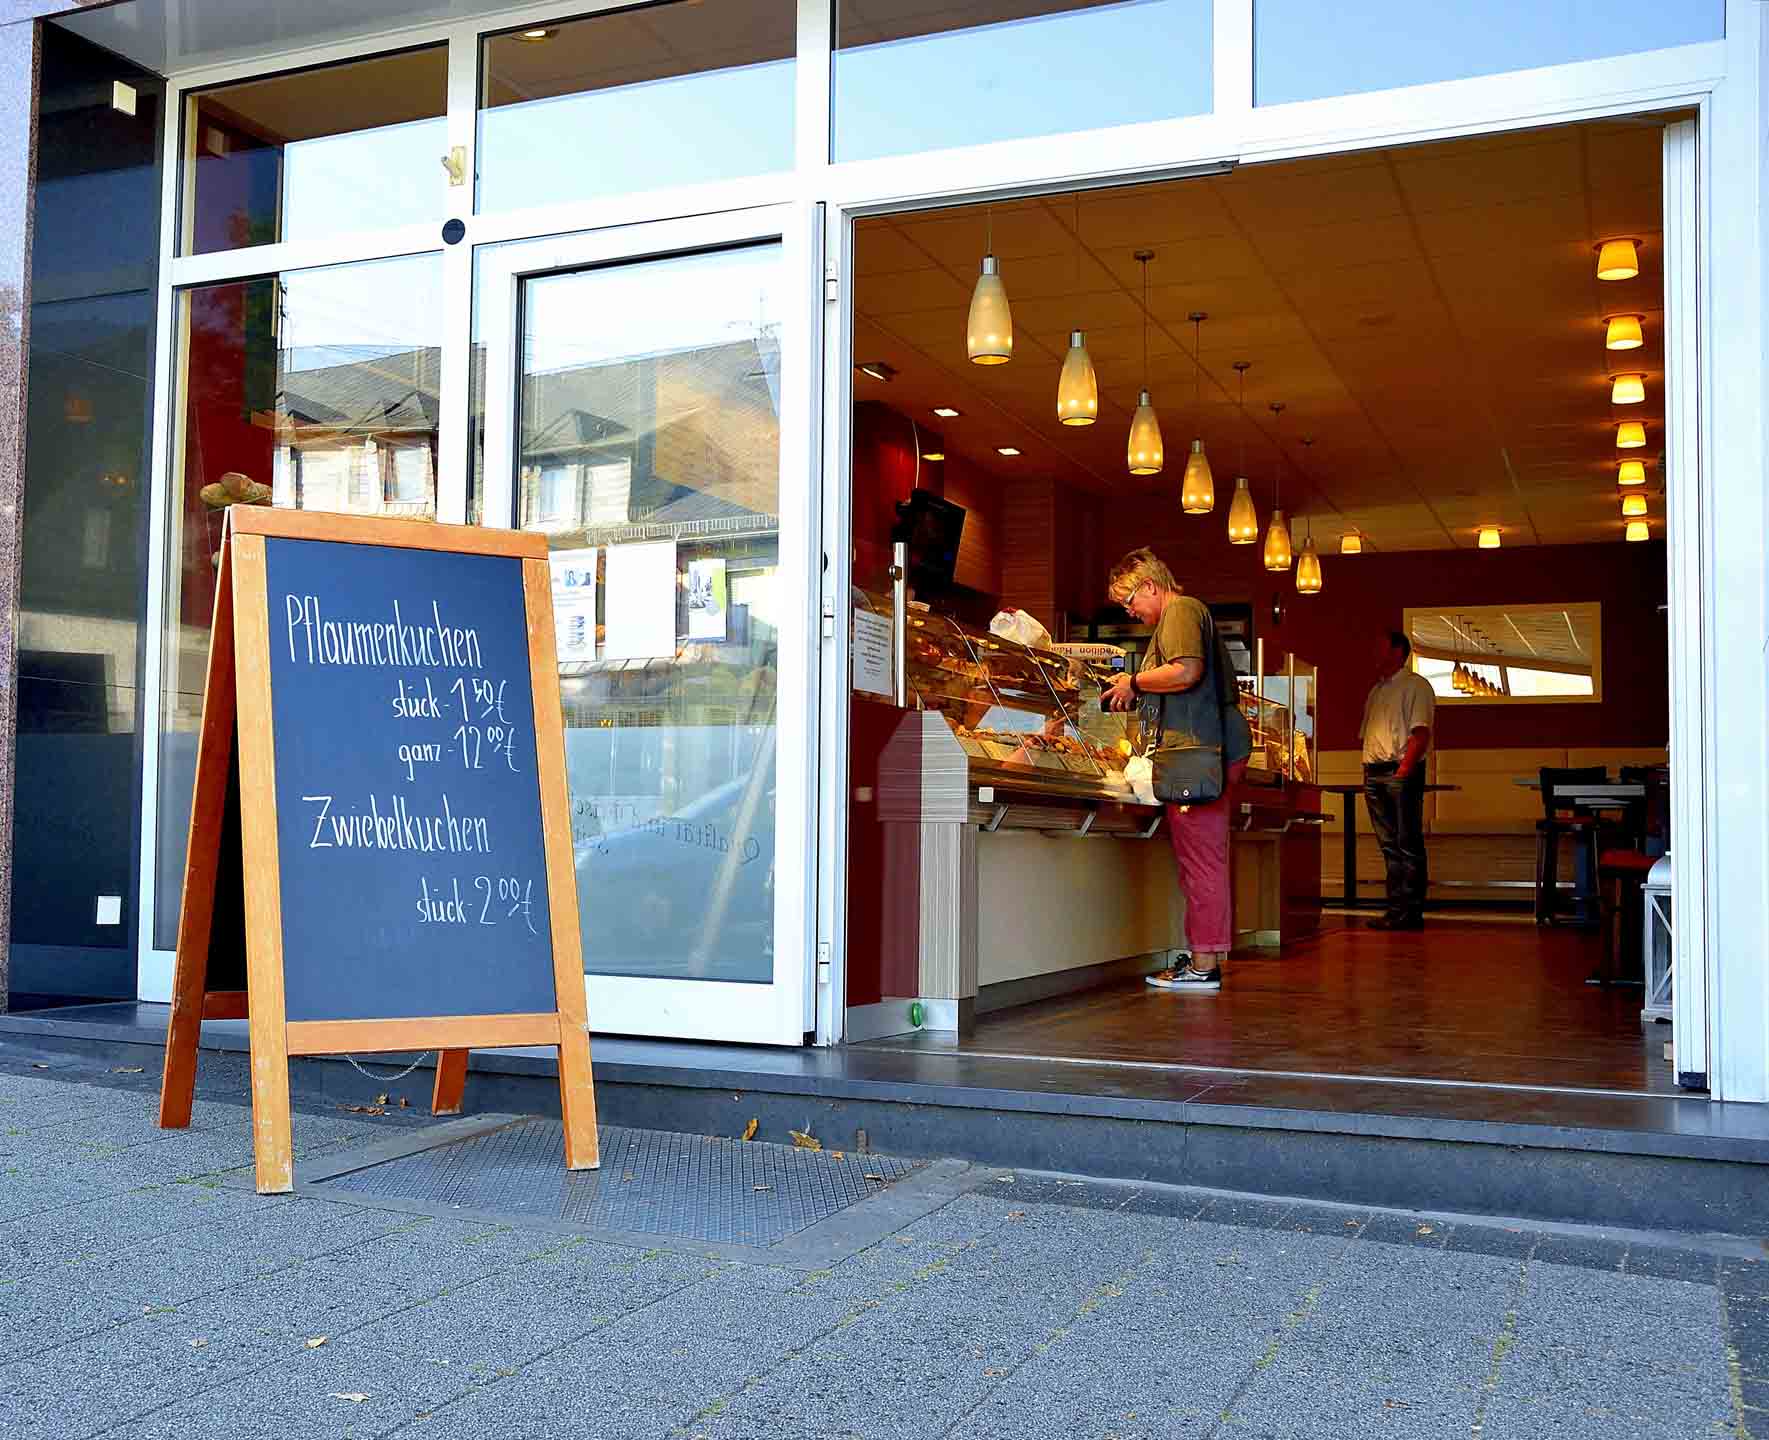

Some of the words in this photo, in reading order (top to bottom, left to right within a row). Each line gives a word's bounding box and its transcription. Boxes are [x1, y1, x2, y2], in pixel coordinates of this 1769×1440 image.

[286, 594, 483, 668] Pflaumenkuchen
[398, 743, 441, 782] ganz
[302, 794, 492, 853] Zwiebelkuchen
